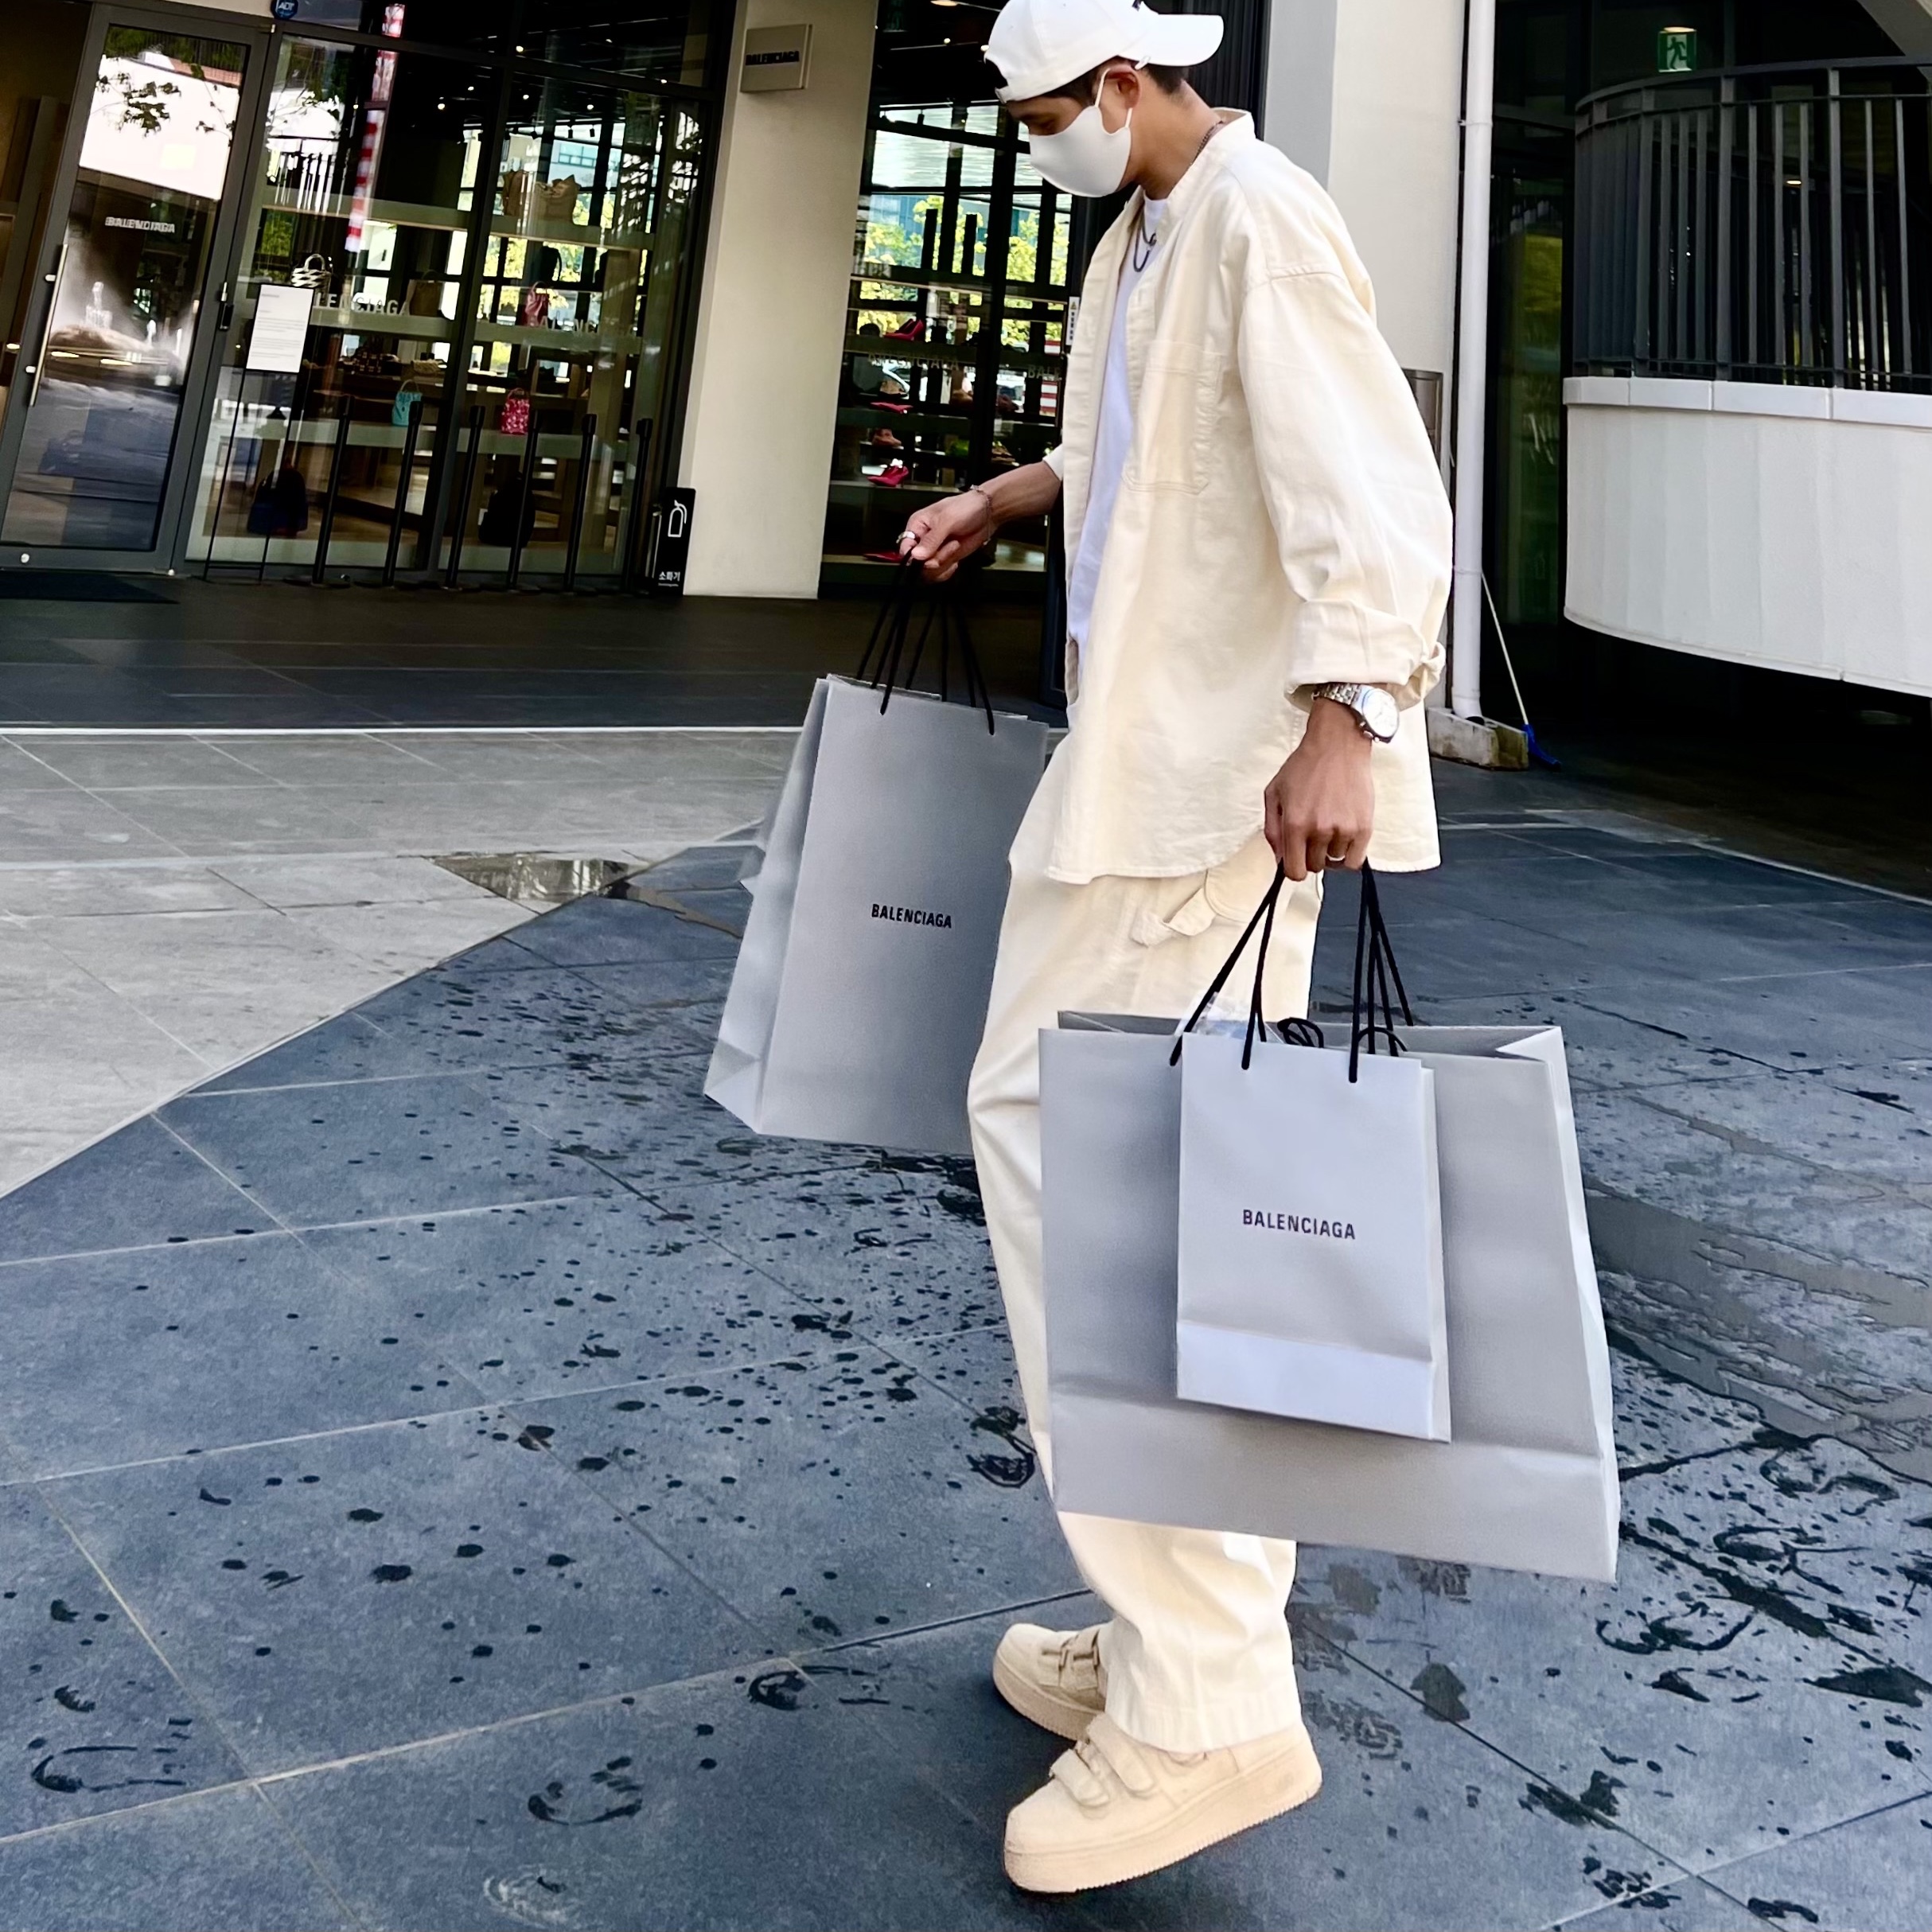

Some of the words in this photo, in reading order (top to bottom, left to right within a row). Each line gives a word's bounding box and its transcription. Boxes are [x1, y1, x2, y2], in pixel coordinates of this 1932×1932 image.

[279, 2, 295, 11] ADT
[871, 903, 952, 929] BALENCIAGA
[1243, 1209, 1356, 1241] BALENCIAGA
